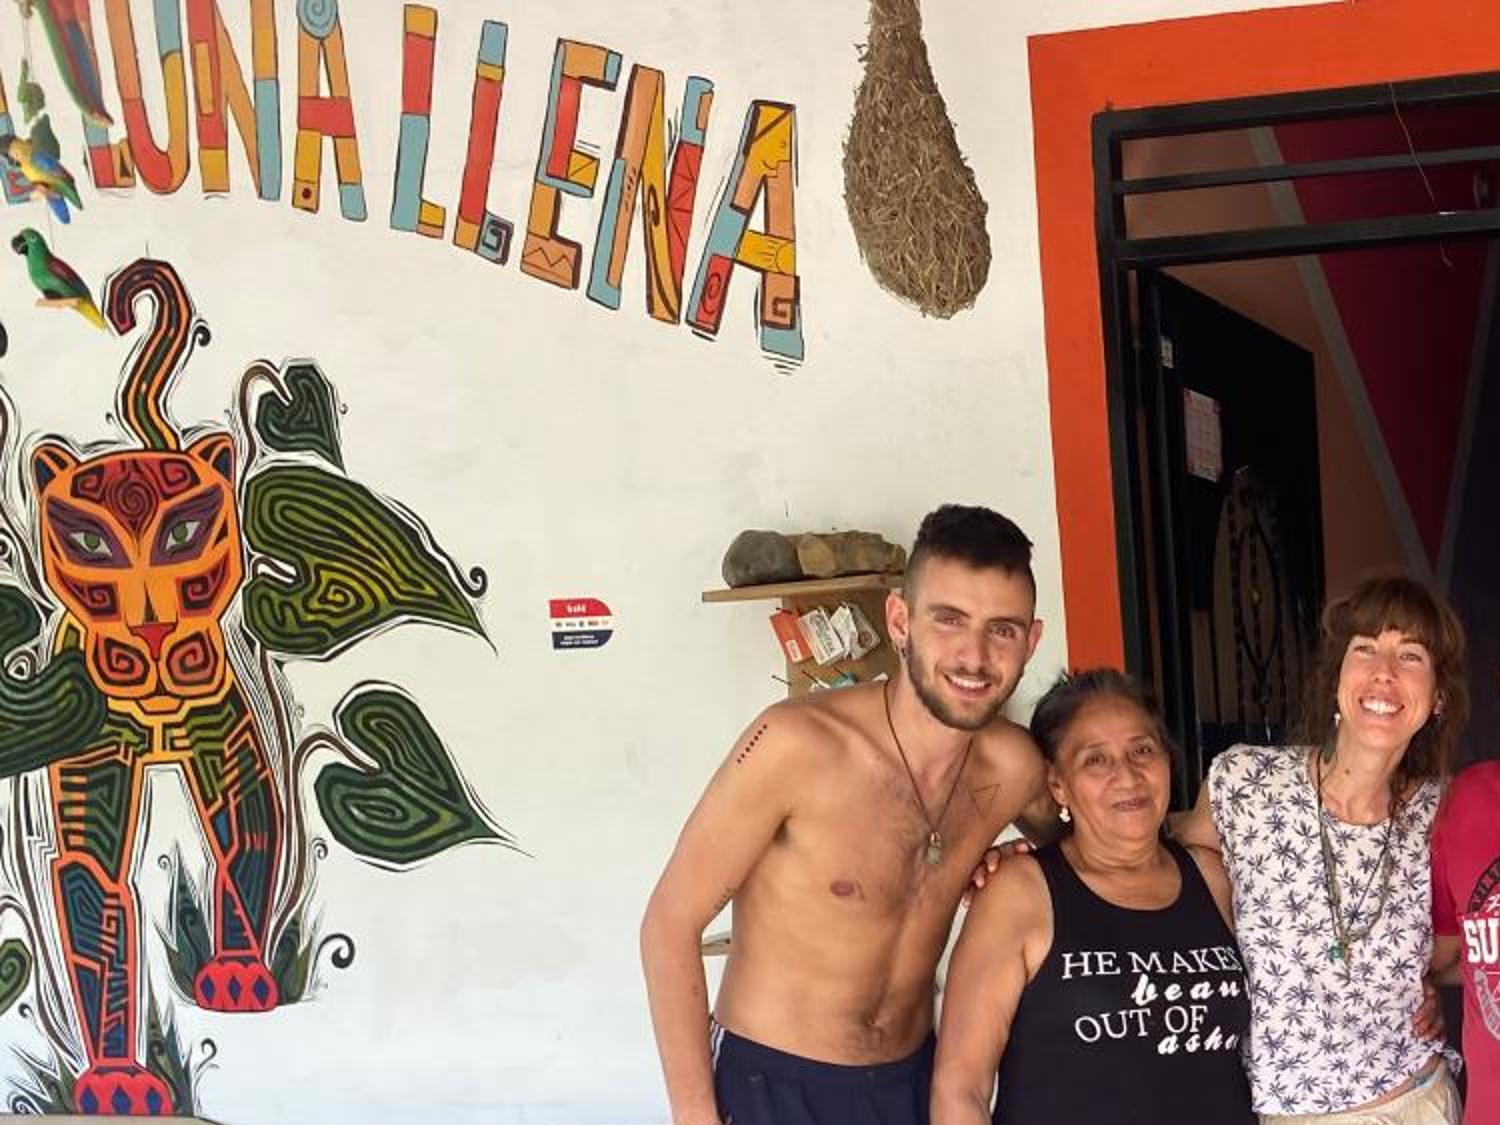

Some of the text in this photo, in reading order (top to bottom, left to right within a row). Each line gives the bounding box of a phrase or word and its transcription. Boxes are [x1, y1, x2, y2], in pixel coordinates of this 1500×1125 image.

[390, 4, 804, 361] LLENA
[1061, 951, 1121, 980] HE
[1075, 1005, 1208, 1043] OUT OF
